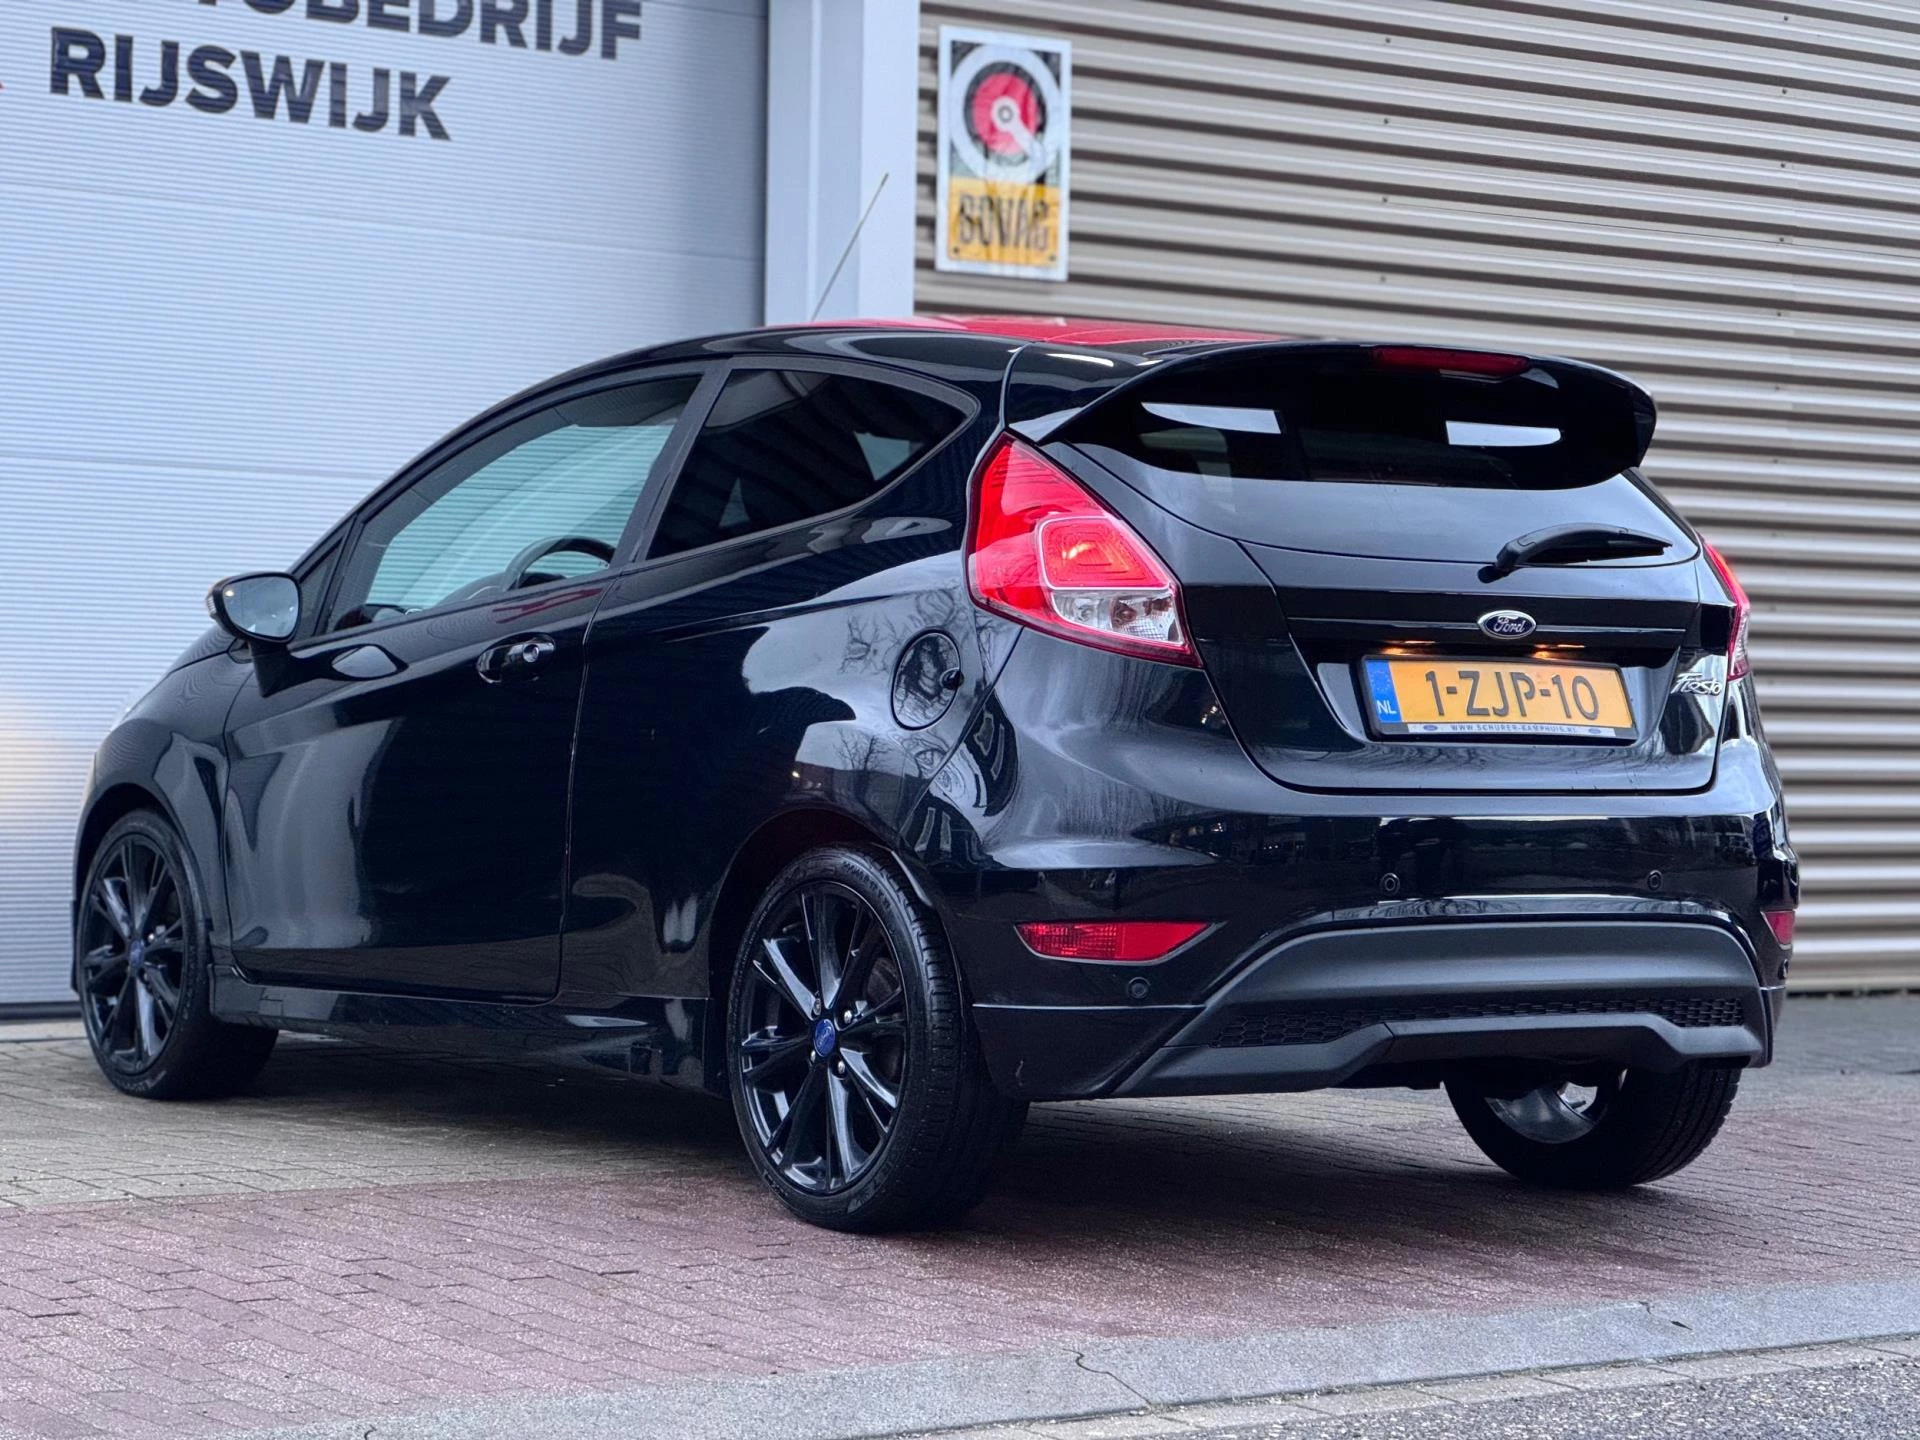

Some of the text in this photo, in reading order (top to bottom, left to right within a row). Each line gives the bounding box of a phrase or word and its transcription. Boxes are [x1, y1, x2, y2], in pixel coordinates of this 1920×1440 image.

[199, 0, 641, 60] DRIJF
[50, 26, 451, 141] RIJSWIJK
[960, 193, 1049, 251] BOVAG
[1493, 615, 1526, 632] Ford
[1376, 699, 1397, 714] NL
[1425, 670, 1599, 720] 1-ZJP-10
